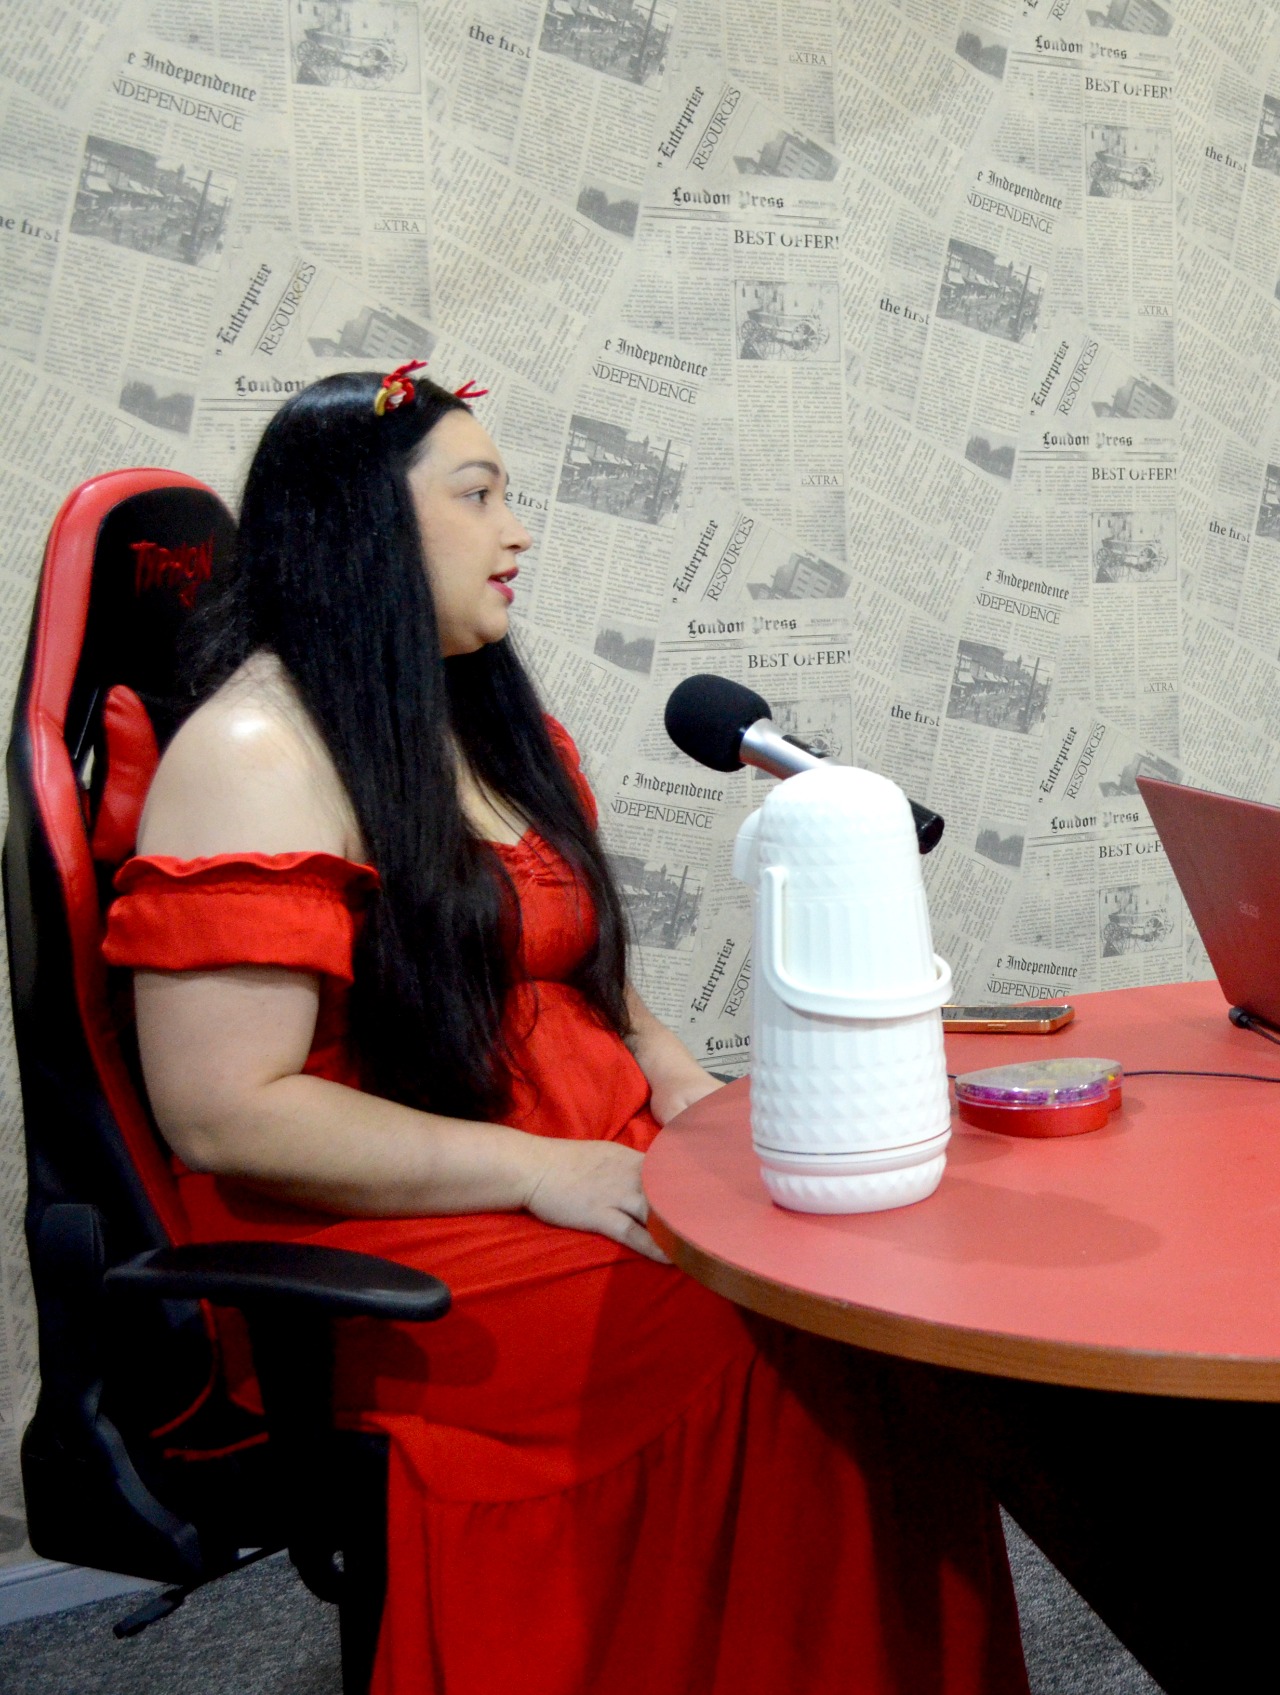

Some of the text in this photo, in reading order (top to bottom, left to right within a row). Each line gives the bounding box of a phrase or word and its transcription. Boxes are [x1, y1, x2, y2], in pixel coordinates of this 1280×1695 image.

[469, 25, 495, 45] the
[1034, 35, 1083, 56] London
[1085, 76, 1120, 95] BEST
[692, 87, 742, 171] RESOURCES
[1205, 146, 1223, 163] the
[672, 187, 731, 209] London
[734, 229, 775, 246] BEST
[259, 262, 317, 356] RESOURCES
[879, 297, 901, 316] the
[1058, 340, 1100, 417] RESOURCES
[1042, 431, 1089, 450] London
[1091, 467, 1126, 481] BEST
[1208, 520, 1227, 535] the
[673, 518, 719, 594] Enterprise
[706, 516, 755, 601] RESOURCES
[687, 619, 745, 638] London
[748, 653, 789, 668] BEST
[891, 704, 911, 721] the
[1067, 723, 1106, 800] RESOURCES
[1050, 815, 1098, 832] London
[1099, 844, 1133, 859] BEST
